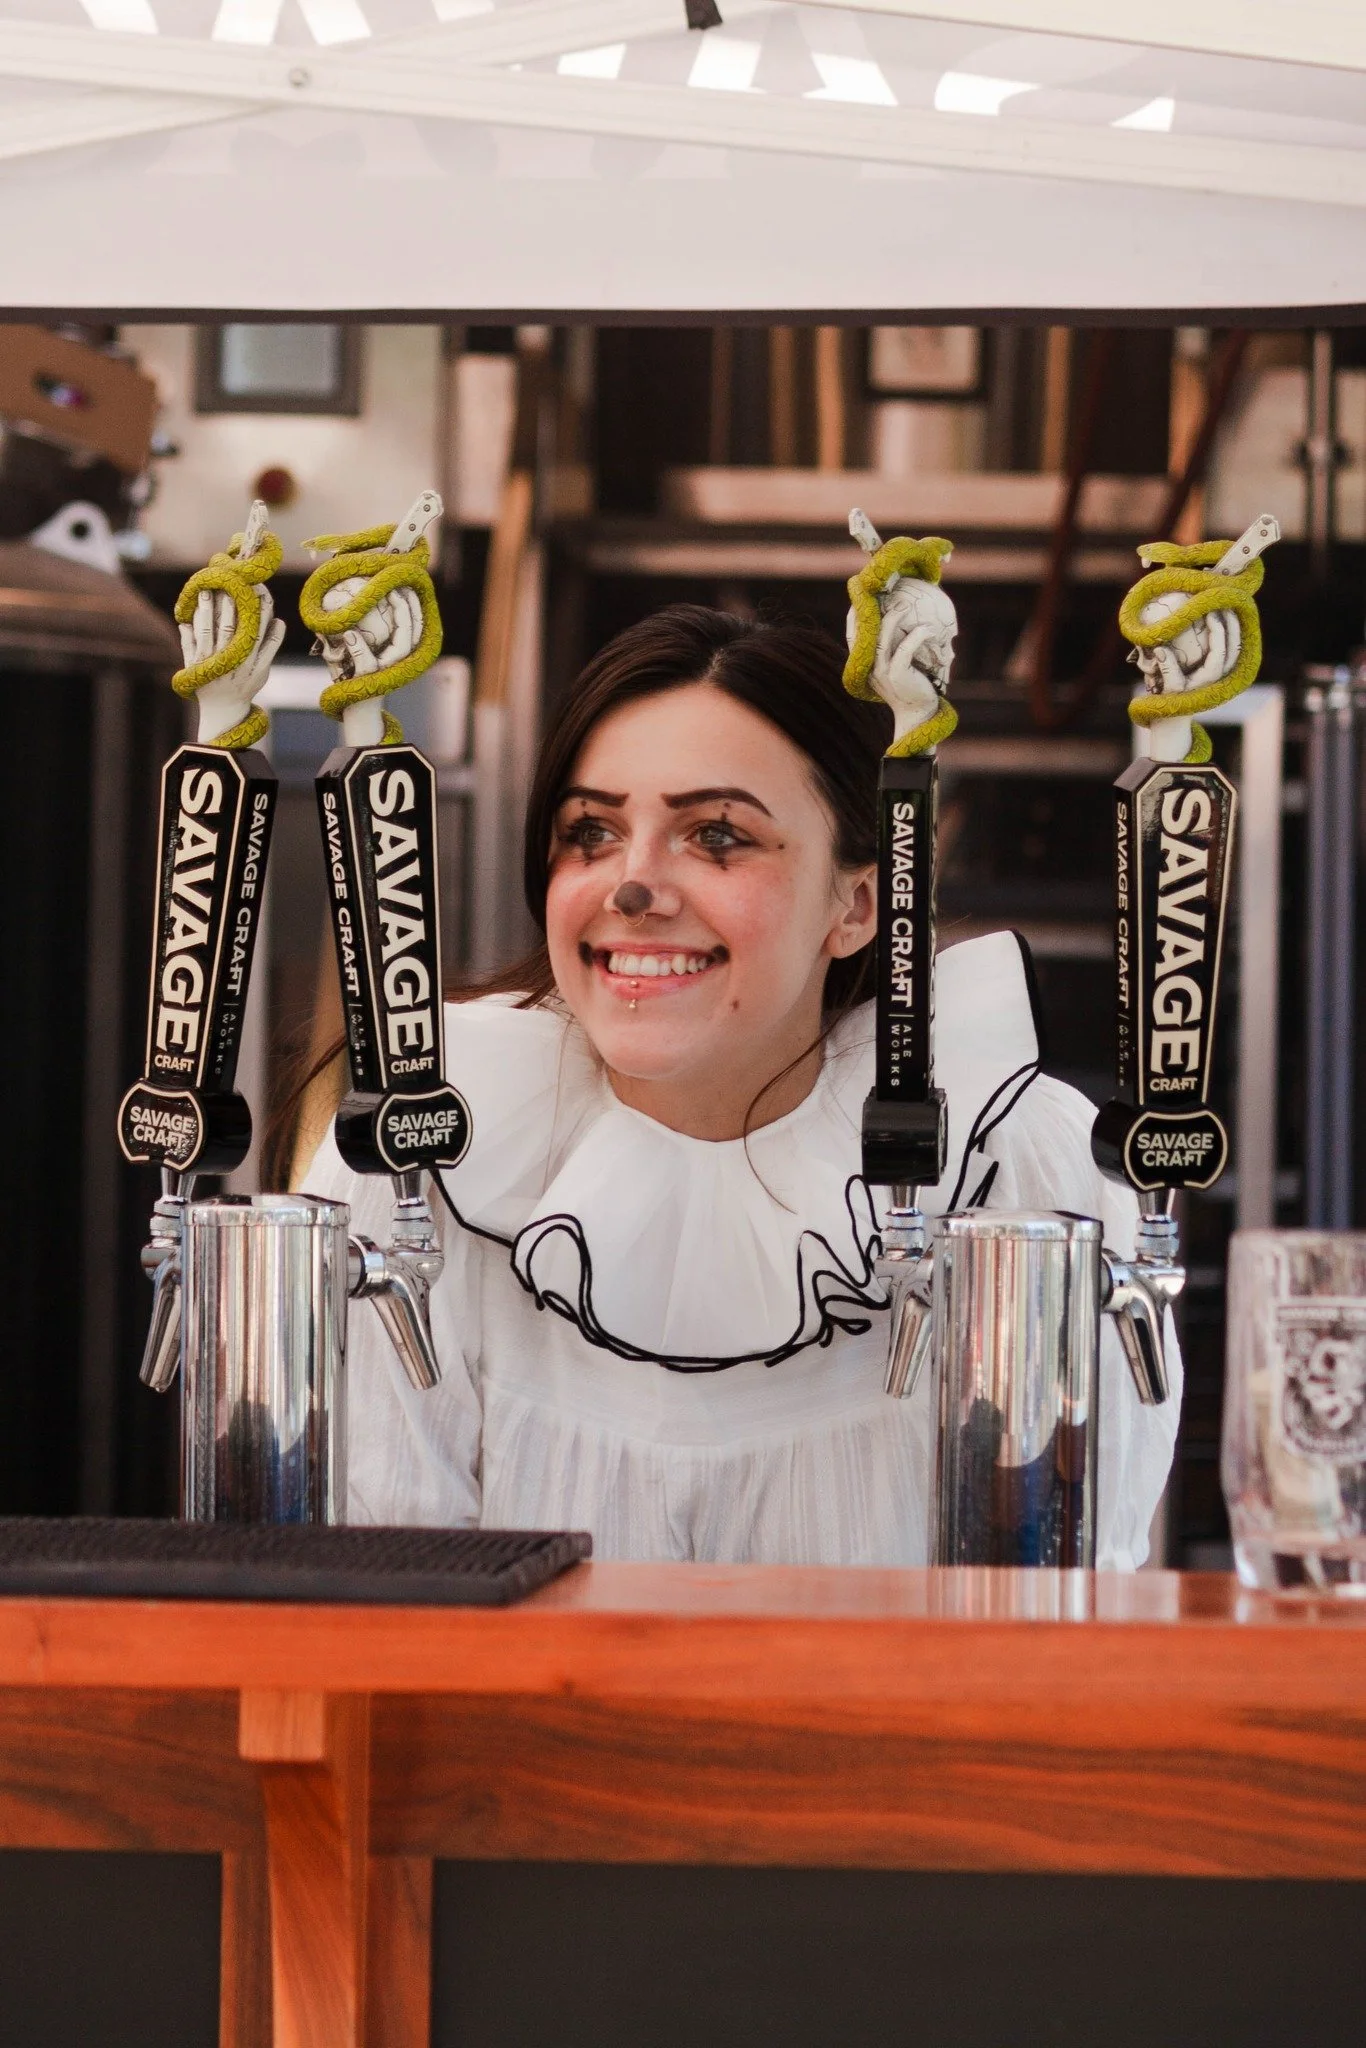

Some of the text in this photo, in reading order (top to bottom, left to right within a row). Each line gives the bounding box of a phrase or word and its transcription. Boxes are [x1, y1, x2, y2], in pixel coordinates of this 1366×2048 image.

[227, 792, 268, 996] SAVAGE CRAFT
[323, 792, 360, 997] SAVAGE CRAFT
[891, 802, 914, 1008] SAVAGE CRAFT
[1116, 801, 1129, 1009] SAVAGE CRAFT
[156, 768, 223, 1054] SAVAGE
[369, 768, 434, 1057] SAVAGE
[1149, 788, 1212, 1075] SAVAGE
[891, 1024, 900, 1087] WORKS
[903, 1024, 912, 1058] ALE
[154, 1054, 194, 1072] CRAFT
[390, 1056, 434, 1075] CRAFT
[1149, 1077, 1198, 1093] CRAFT
[130, 1106, 195, 1134] SAVAGE
[387, 1109, 459, 1133] SAVAGE
[133, 1124, 187, 1149] CRAFT
[394, 1128, 454, 1149] CRAFT
[1136, 1132, 1214, 1150] SAVAGE
[1141, 1150, 1206, 1167] CRAFT
